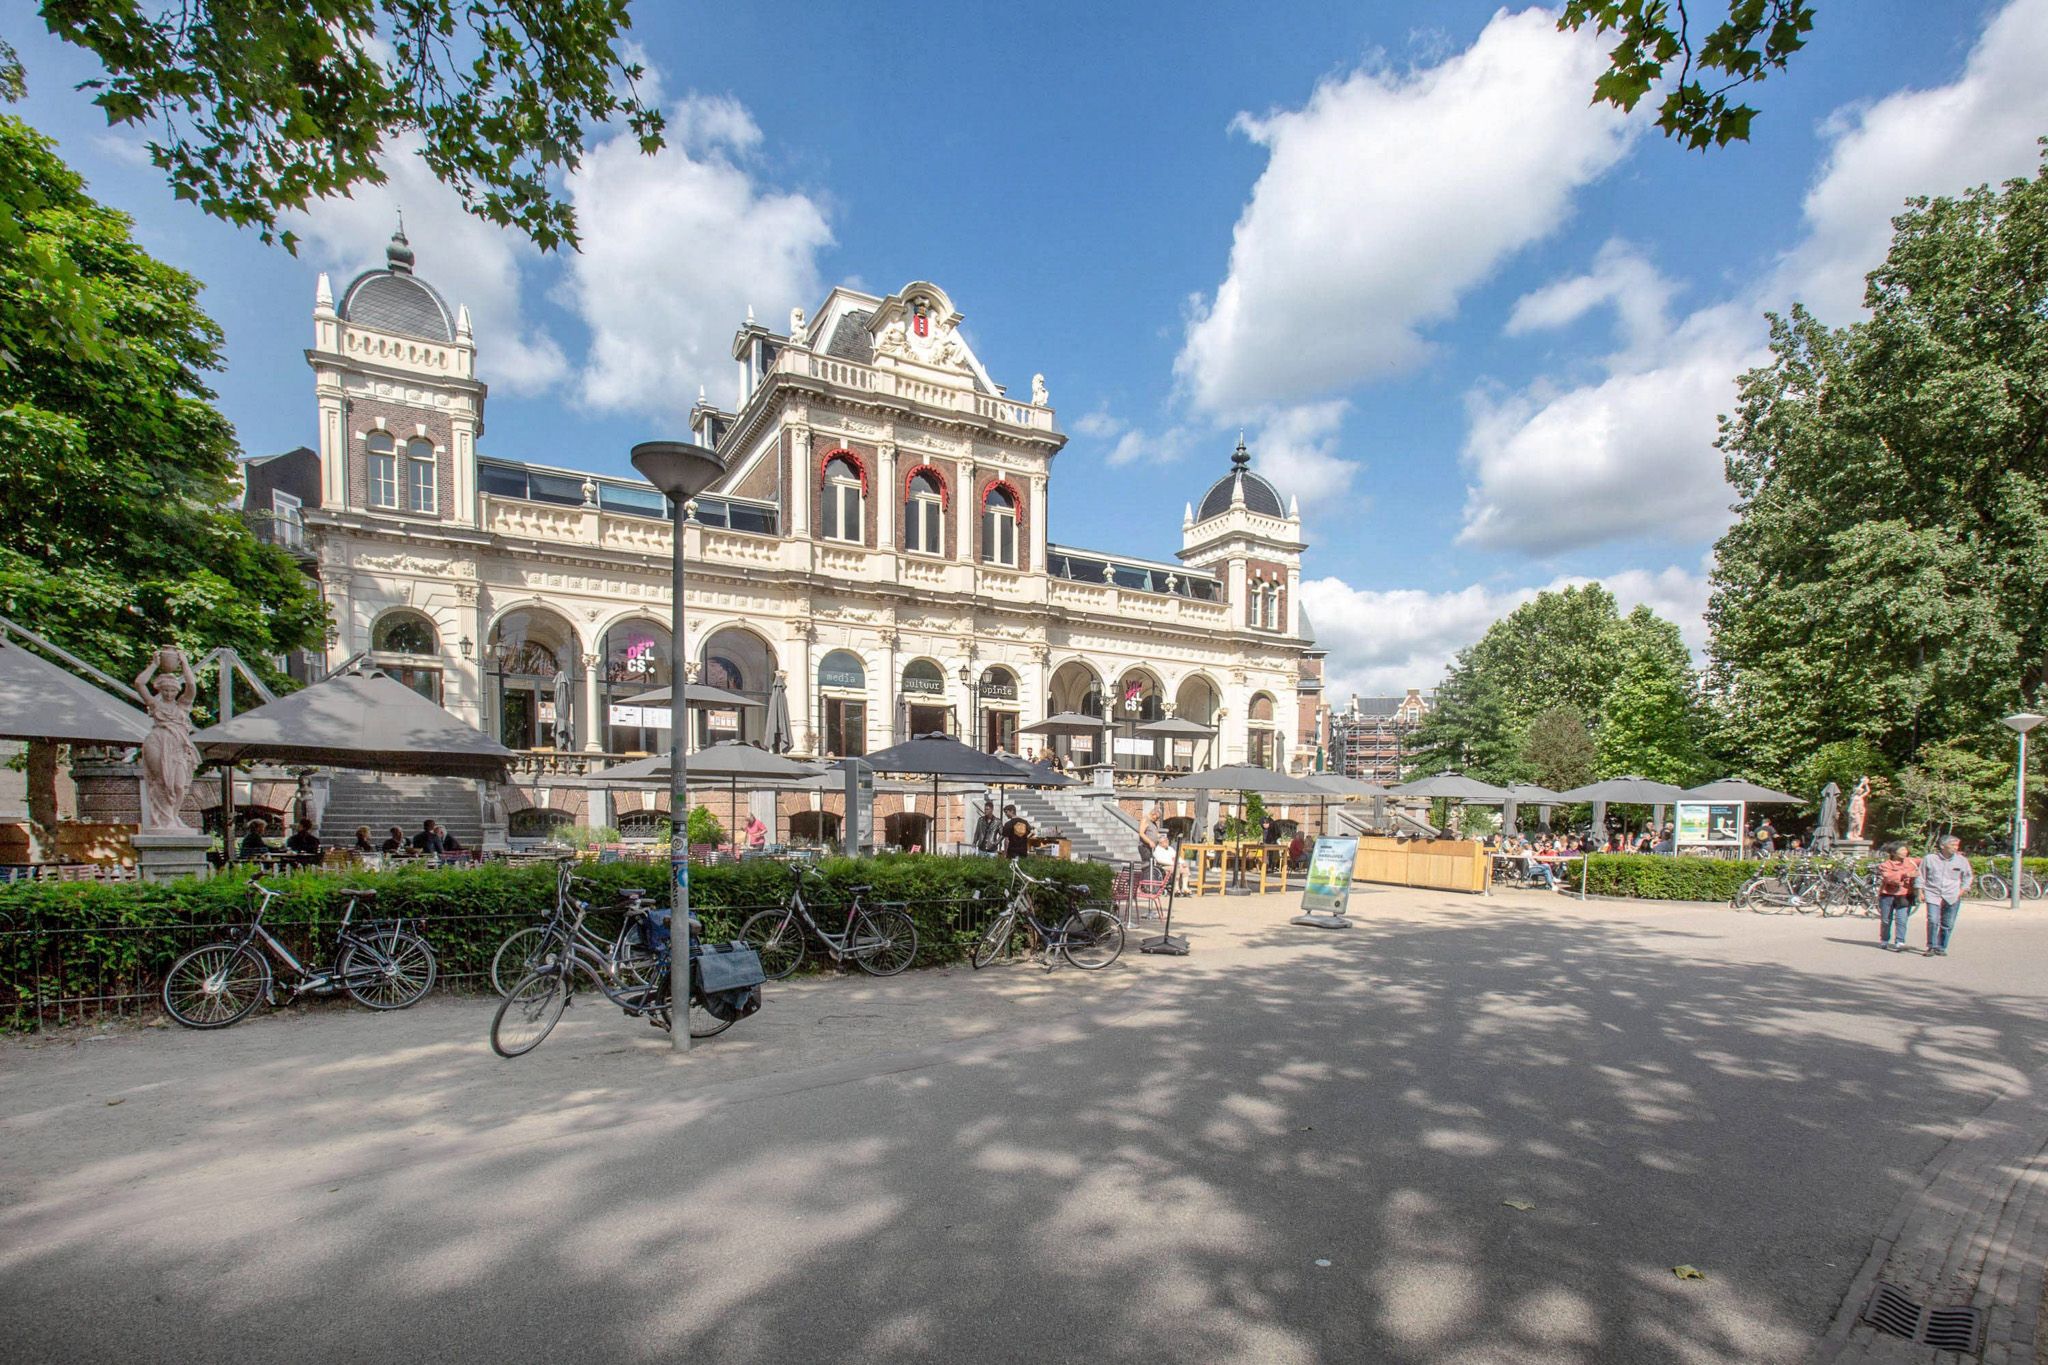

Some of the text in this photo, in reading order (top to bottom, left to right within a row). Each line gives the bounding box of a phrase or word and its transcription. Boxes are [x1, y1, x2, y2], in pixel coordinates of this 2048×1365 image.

[826, 672, 857, 683] media
[905, 679, 940, 690] cultuur
[983, 685, 1013, 696] opinie
